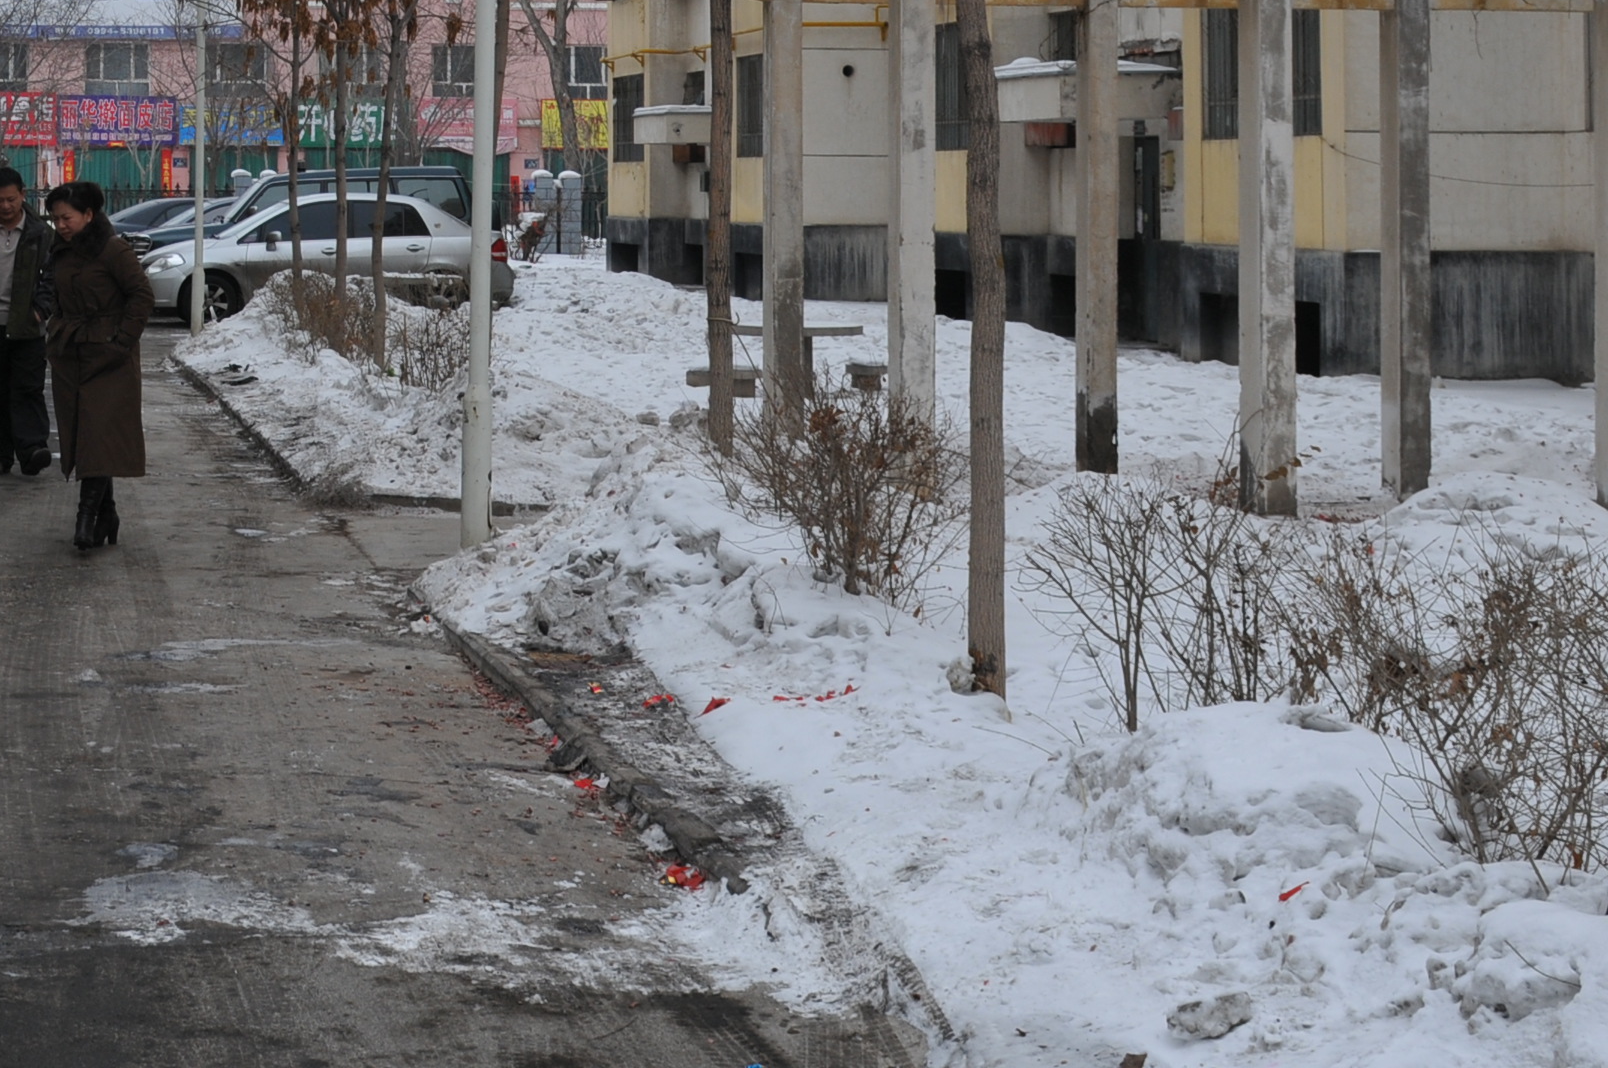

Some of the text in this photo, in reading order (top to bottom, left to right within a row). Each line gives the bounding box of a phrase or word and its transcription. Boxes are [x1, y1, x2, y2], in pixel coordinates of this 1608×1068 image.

[60, 98, 174, 131] 丽华擀面皮店
